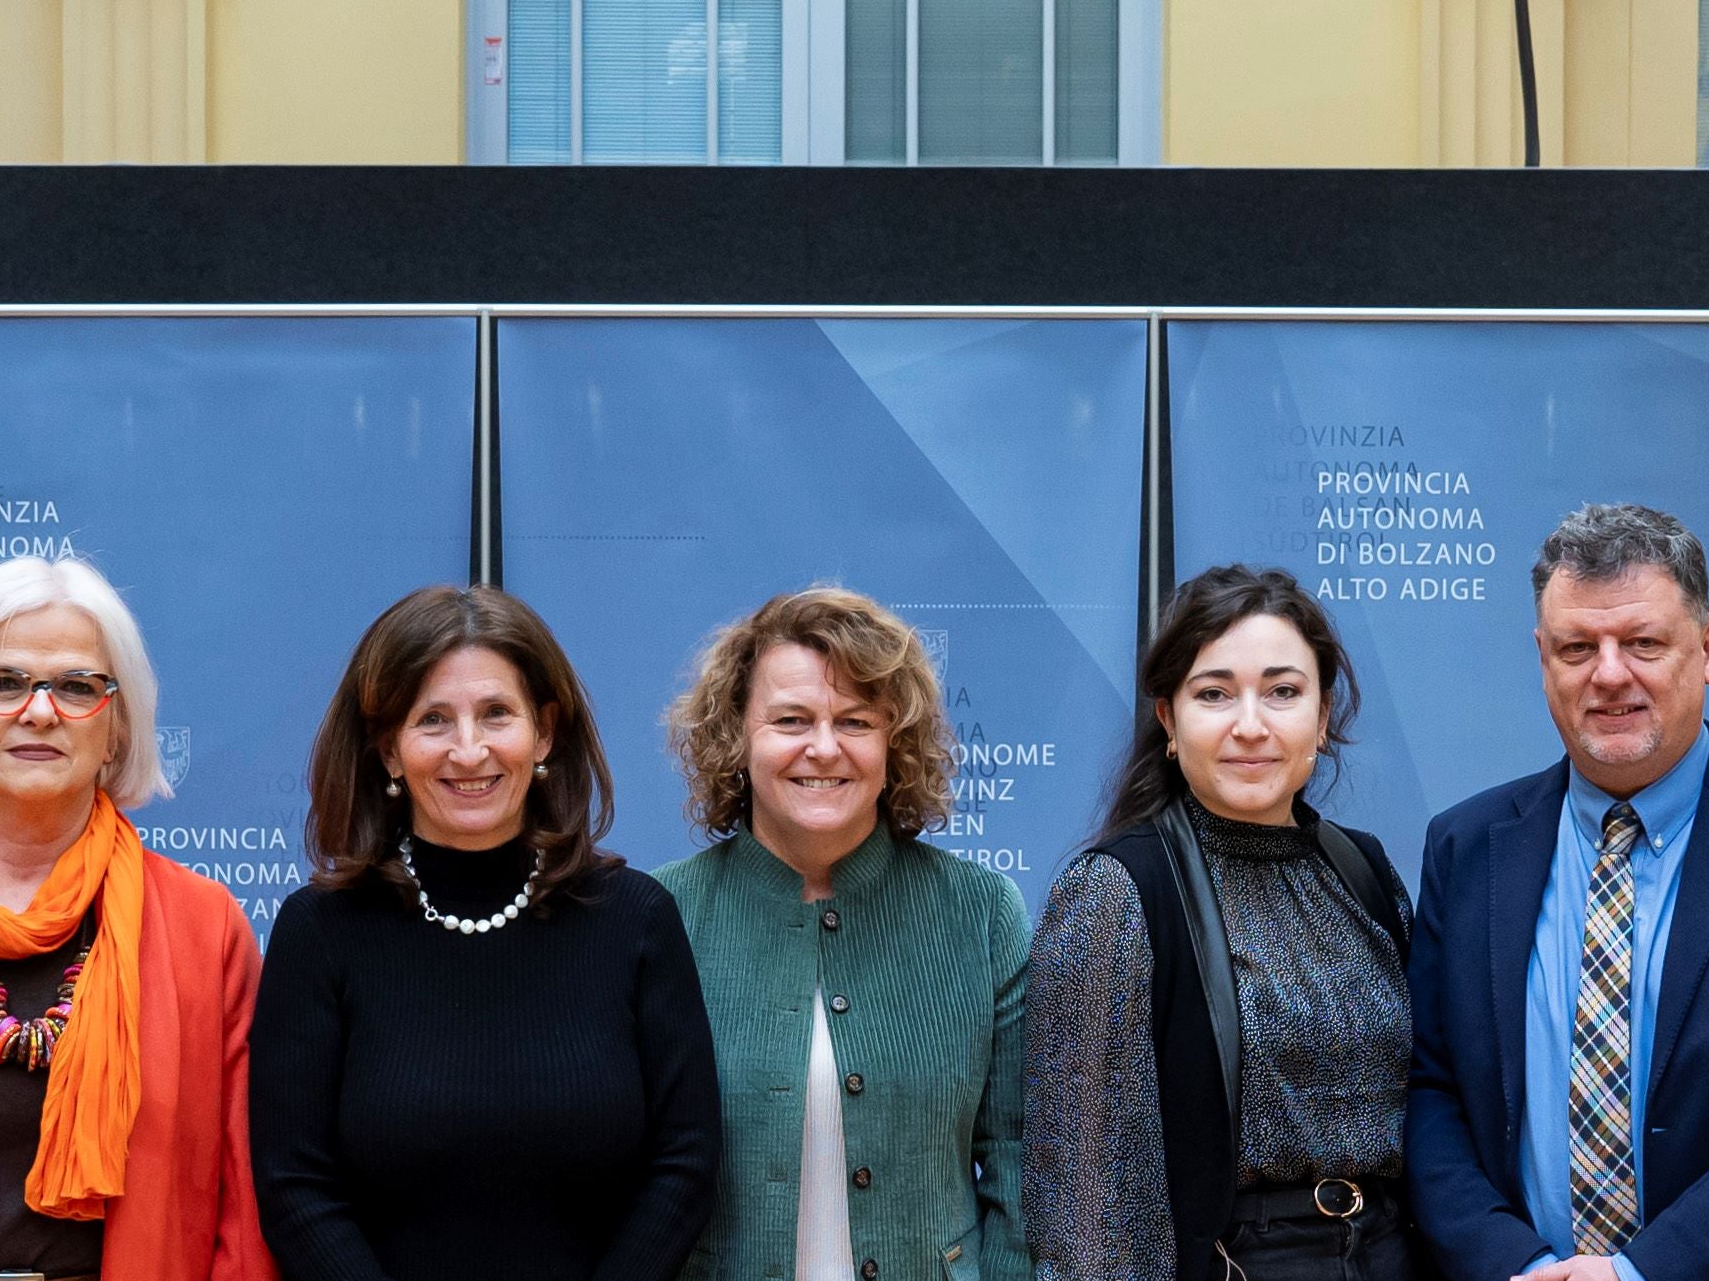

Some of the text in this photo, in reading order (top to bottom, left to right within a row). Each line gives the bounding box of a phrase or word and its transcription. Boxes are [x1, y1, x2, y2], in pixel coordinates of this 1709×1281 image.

[1318, 472, 1471, 494] PROVINCIA
[1317, 507, 1485, 529] AUTONOMA
[1318, 542, 1496, 565] DI BOLZANO
[1317, 578, 1486, 600] ALTO ADIGE
[138, 827, 287, 850] PROVINCIA
